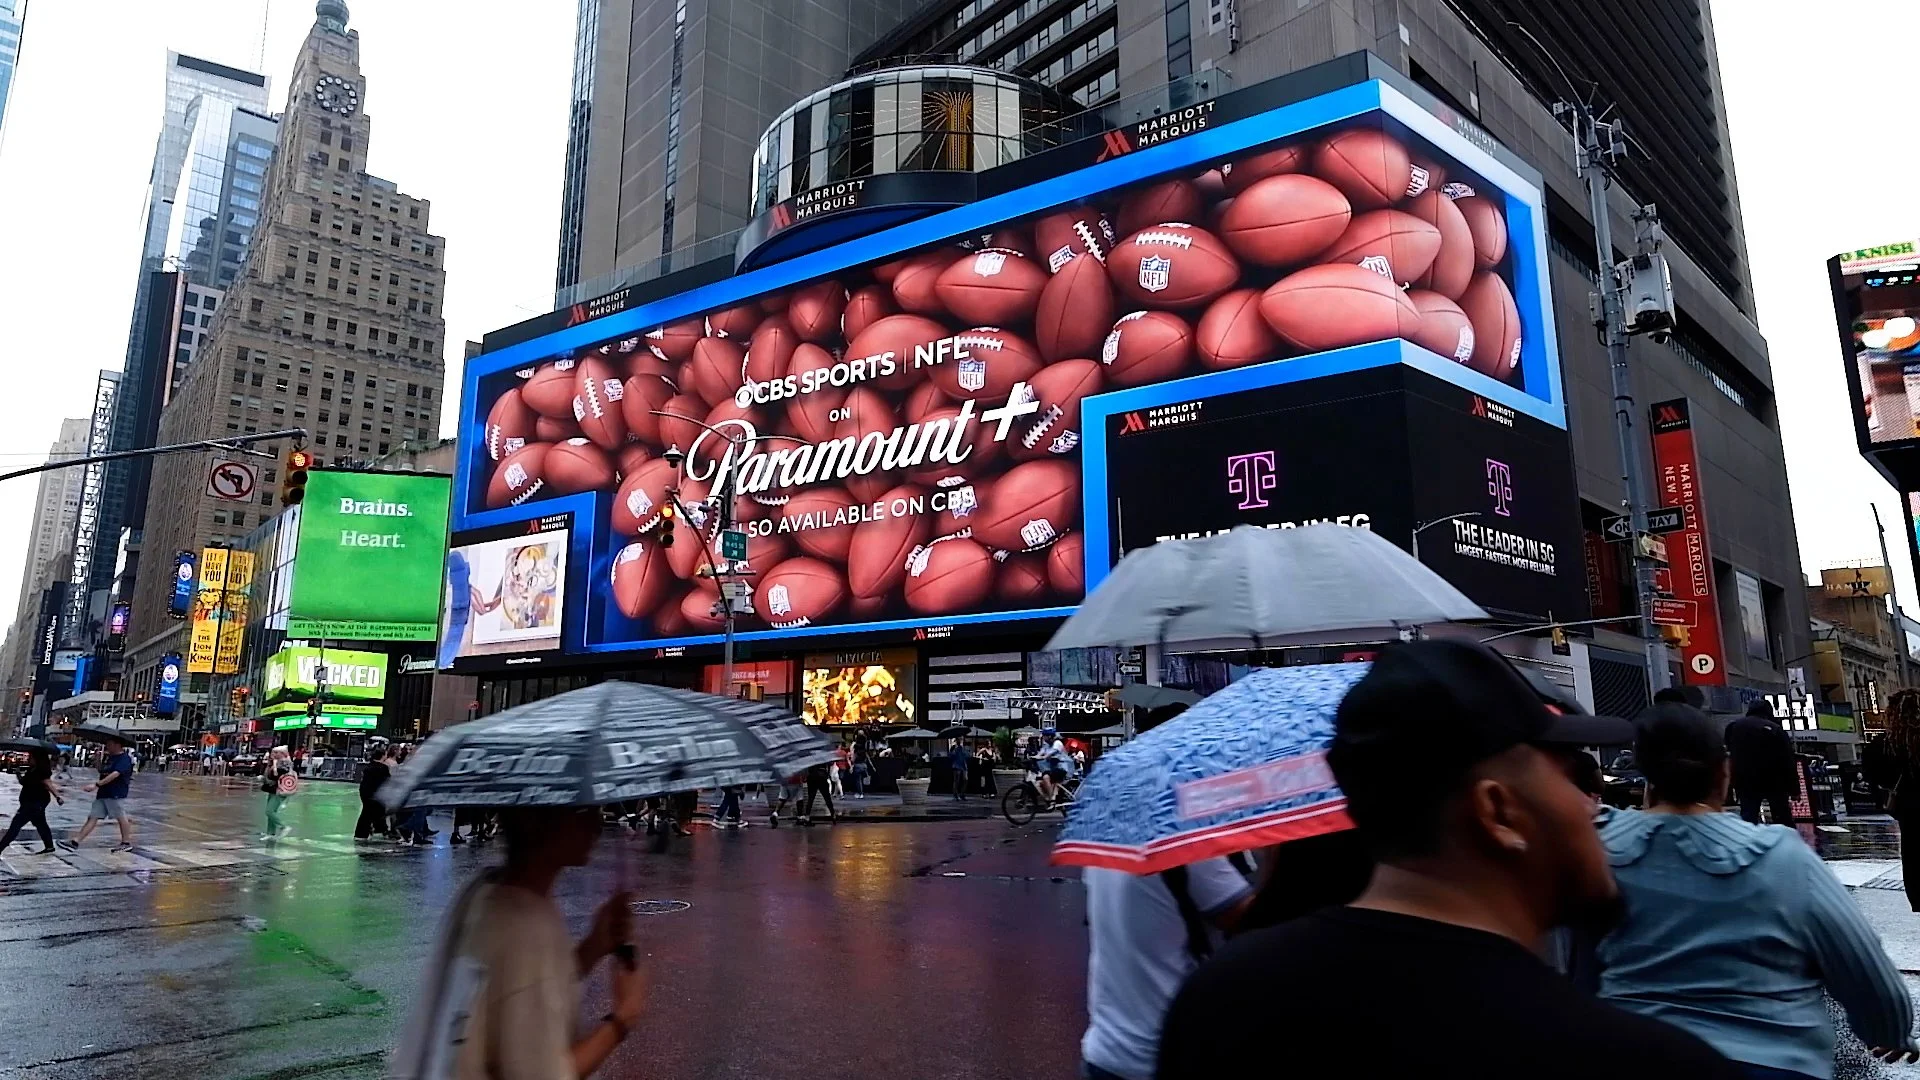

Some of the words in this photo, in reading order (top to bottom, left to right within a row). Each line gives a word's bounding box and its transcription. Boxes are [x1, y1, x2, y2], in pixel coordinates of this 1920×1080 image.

[1138, 101, 1215, 133] MARRIOTT
[1139, 118, 1206, 147] MARQUIS
[797, 180, 865, 206] MARRIOTT
[796, 195, 855, 220] MARQUIS
[1855, 242, 1913, 260] KNISH
[1143, 271, 1163, 287] NFL
[590, 289, 630, 308] MARRIOTT
[589, 301, 625, 318] MARQUIS
[752, 380, 798, 405] CBS
[800, 351, 896, 394] SPORTS
[913, 334, 971, 368] NFL
[962, 373, 982, 387] NFL
[829, 406, 851, 423] ON
[1149, 401, 1203, 418] MARRIOTT
[1487, 401, 1515, 419] MARRIOTT
[1149, 412, 1197, 427] MARQUIS
[1487, 411, 1513, 427] MARQUIS
[1664, 466, 1677, 493] NEW
[339, 497, 413, 517] Brains.
[777, 501, 886, 533] AVAILABLE
[891, 495, 924, 518] ON
[1679, 463, 1697, 530] MARRIOTT
[1689, 534, 1707, 595] MARQUIS
[340, 530, 406, 548] Heart.
[1453, 518, 1479, 545] THE
[1480, 526, 1526, 557] LEADER
[1526, 538, 1540, 561] IN
[1540, 543, 1555, 564] 5G
[1512, 556, 1530, 571] MOST
[204, 570, 221, 582] YOU
[1826, 581, 1889, 592] HAMILTO
[193, 643, 212, 651] LION
[189, 653, 213, 663] KING
[836, 650, 883, 664] INVICTA
[1698, 658, 1709, 671] P
[446, 748, 571, 776] Berlin
[607, 736, 740, 770] Berlin
